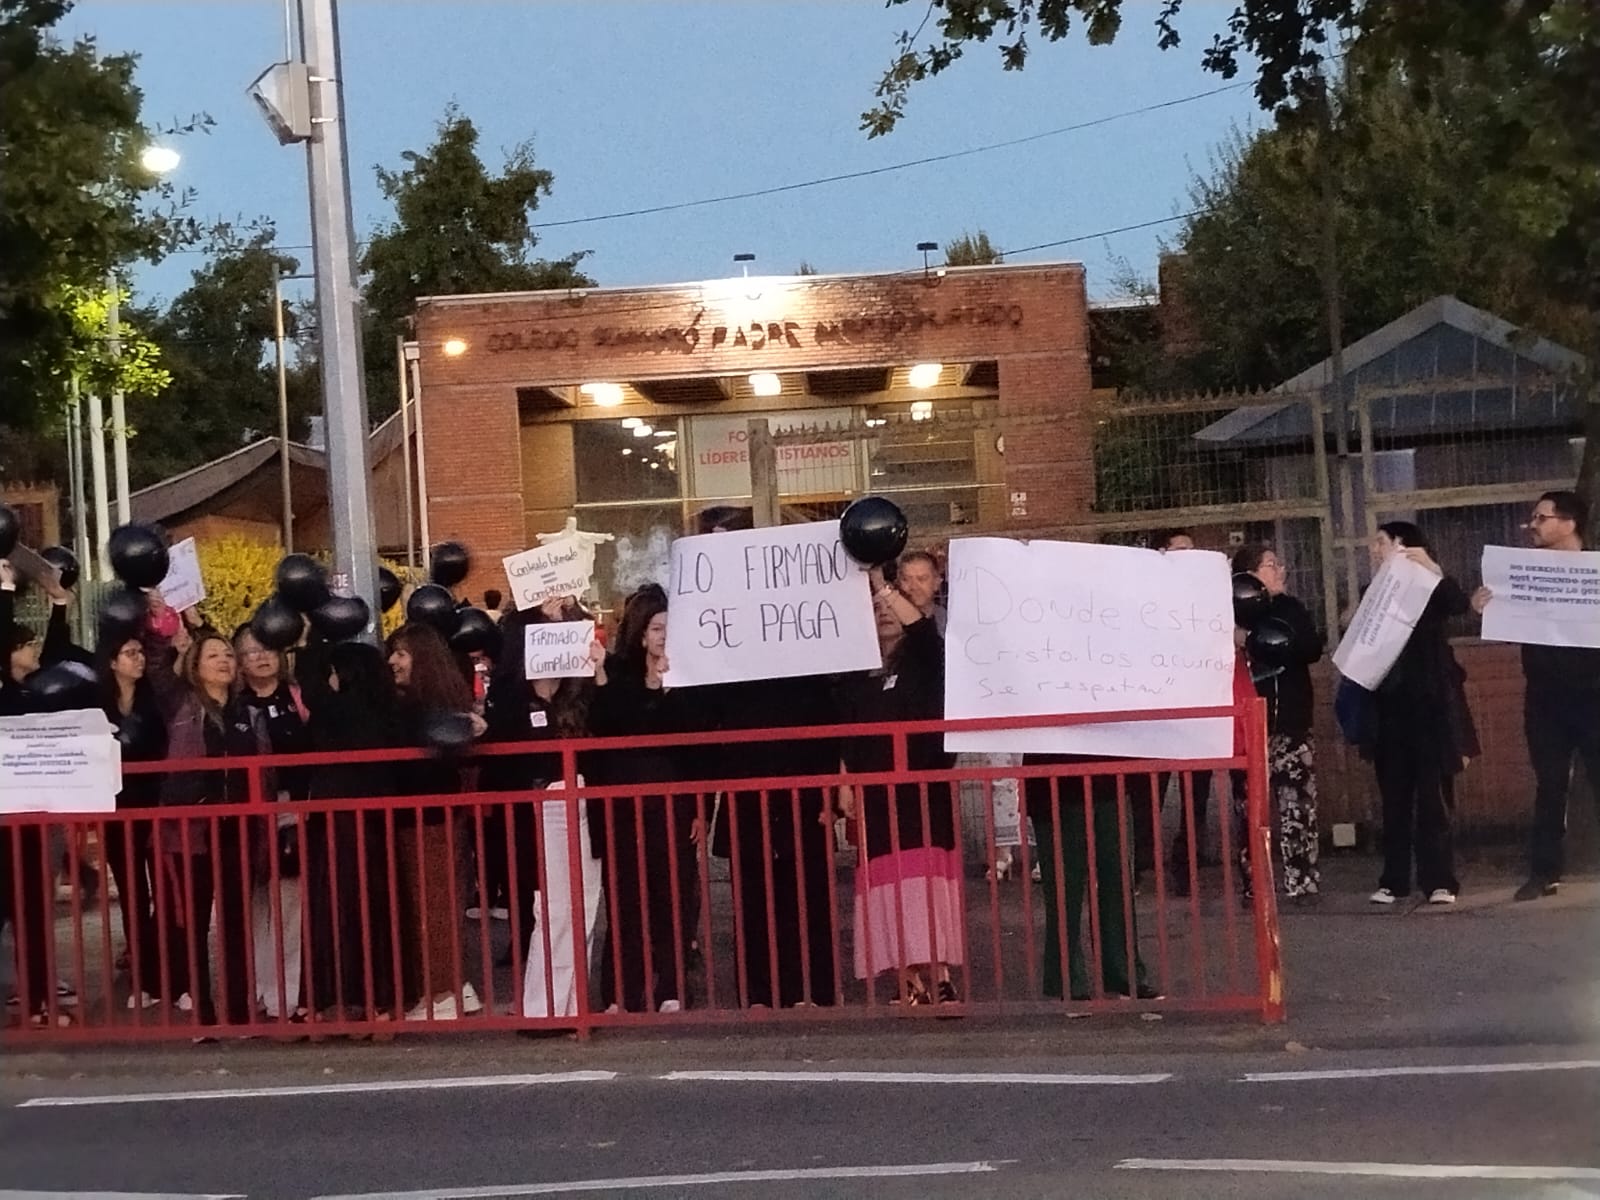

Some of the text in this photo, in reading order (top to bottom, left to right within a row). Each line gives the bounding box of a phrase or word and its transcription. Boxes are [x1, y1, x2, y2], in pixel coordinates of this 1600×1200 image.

[699, 448, 748, 465] LÍDERE
[677, 539, 848, 596] LO FIRMADO
[698, 600, 840, 649] SE PAGA
